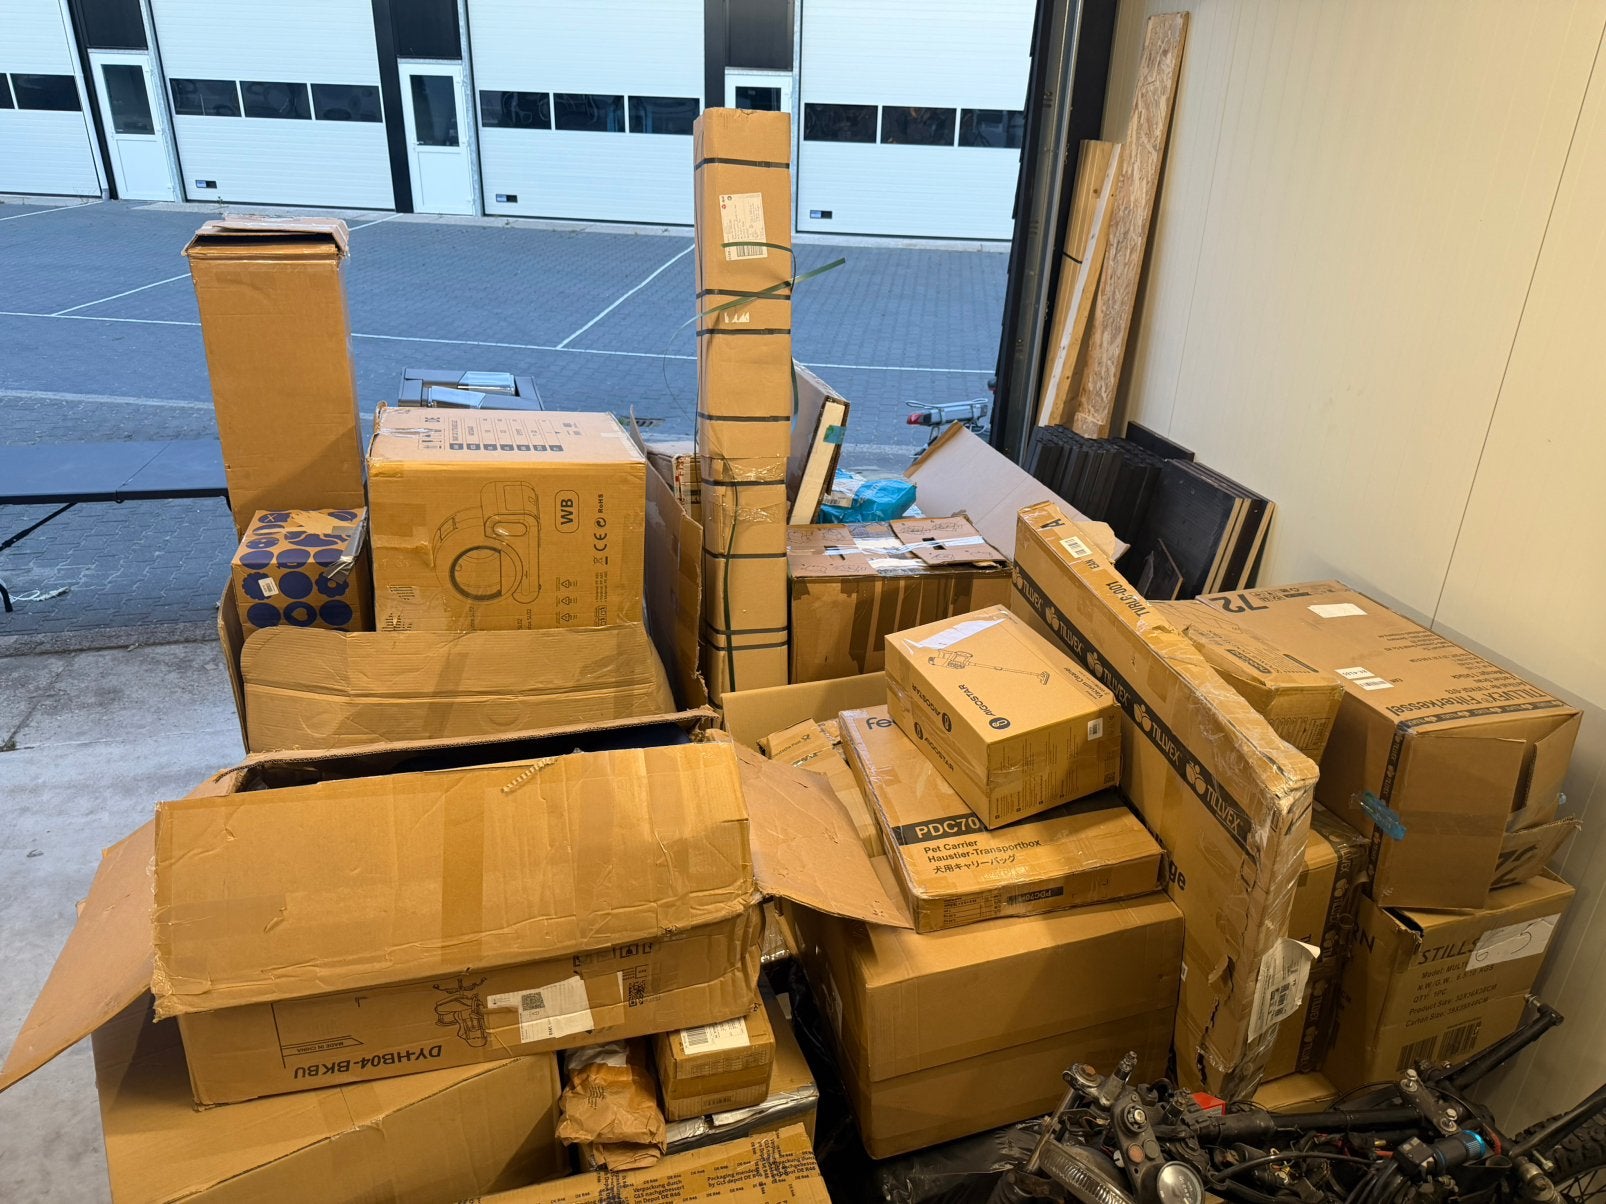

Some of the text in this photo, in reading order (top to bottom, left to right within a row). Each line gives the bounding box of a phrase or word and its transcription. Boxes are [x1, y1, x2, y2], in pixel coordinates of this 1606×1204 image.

[560, 498, 574, 525] WB
[1040, 518, 1065, 529] A
[1023, 580, 1042, 612] TILLVEX
[1208, 593, 1269, 613] 72
[1060, 620, 1083, 656] TILLVEX
[1103, 666, 1130, 706] TILLVEX
[958, 684, 996, 717] AIGOSTAR
[1385, 693, 1482, 716] Filterkessel
[866, 717, 896, 730] fe
[1152, 723, 1182, 767] TILLVEX
[1206, 786, 1242, 836] TILLVEX
[924, 839, 978, 855] Pet Carrier
[927, 839, 1042, 864] Haustier-Transportbox
[933, 854, 1017, 874] 犬用キャリーバッグ
[1409, 1002, 1437, 1016] Product
[297, 1045, 317, 1053] CHINA
[326, 1041, 344, 1049] MADE
[293, 1045, 443, 1079] DY-HB04-BKBU
[707, 1172, 735, 1181] Packaging
[727, 1176, 743, 1184] depot
[633, 1183, 666, 1193] Verpackung
[645, 1185, 684, 1197] nachgebessert
[643, 1196, 660, 1204] Depot
